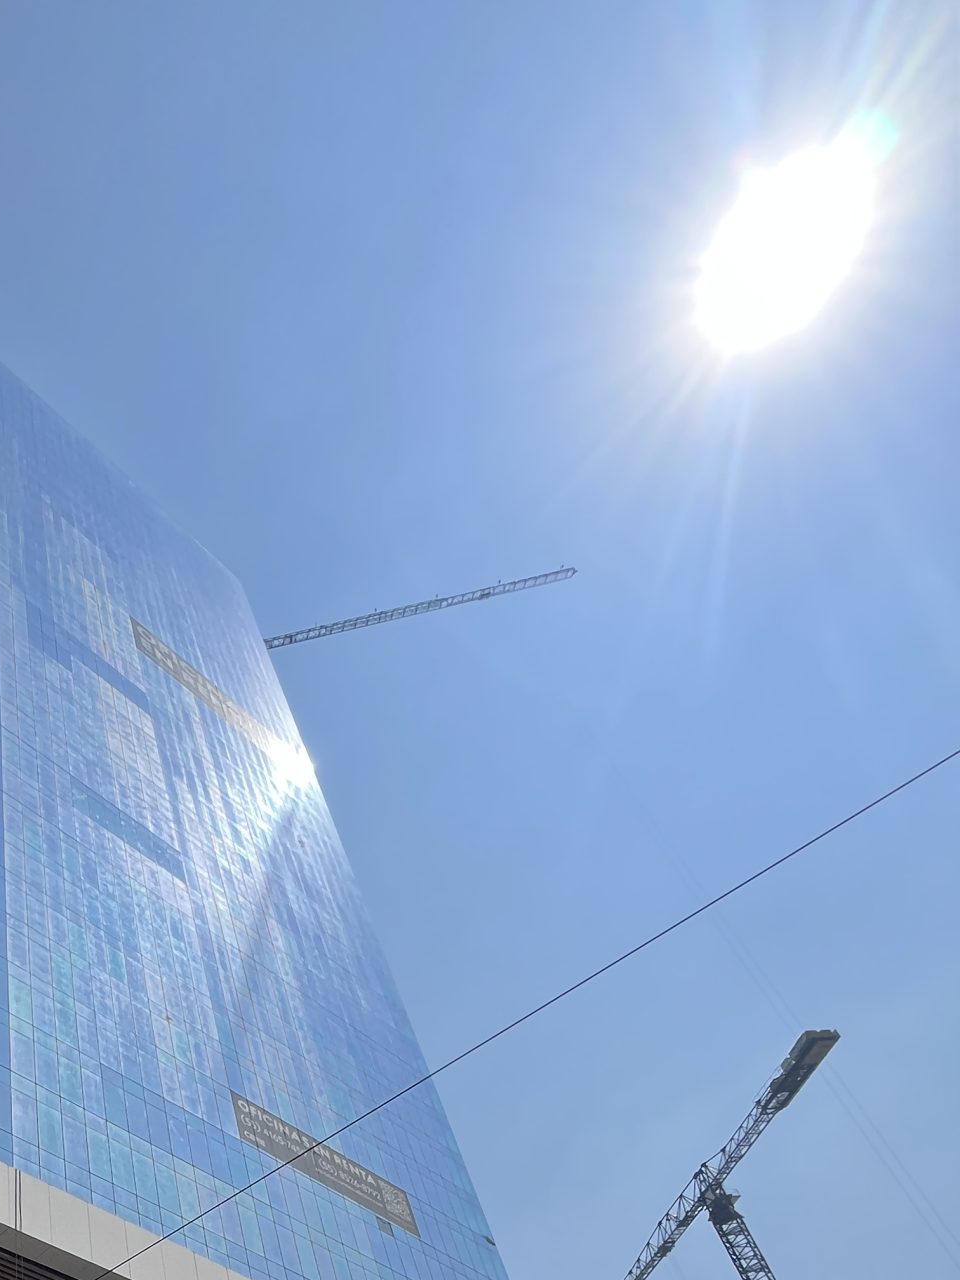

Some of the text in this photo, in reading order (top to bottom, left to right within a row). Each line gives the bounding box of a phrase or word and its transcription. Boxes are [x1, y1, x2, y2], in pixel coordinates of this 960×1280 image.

[238, 1099, 310, 1149] OFICINAS
[311, 1141, 332, 1161] EN
[332, 1153, 378, 1187] RENTA
